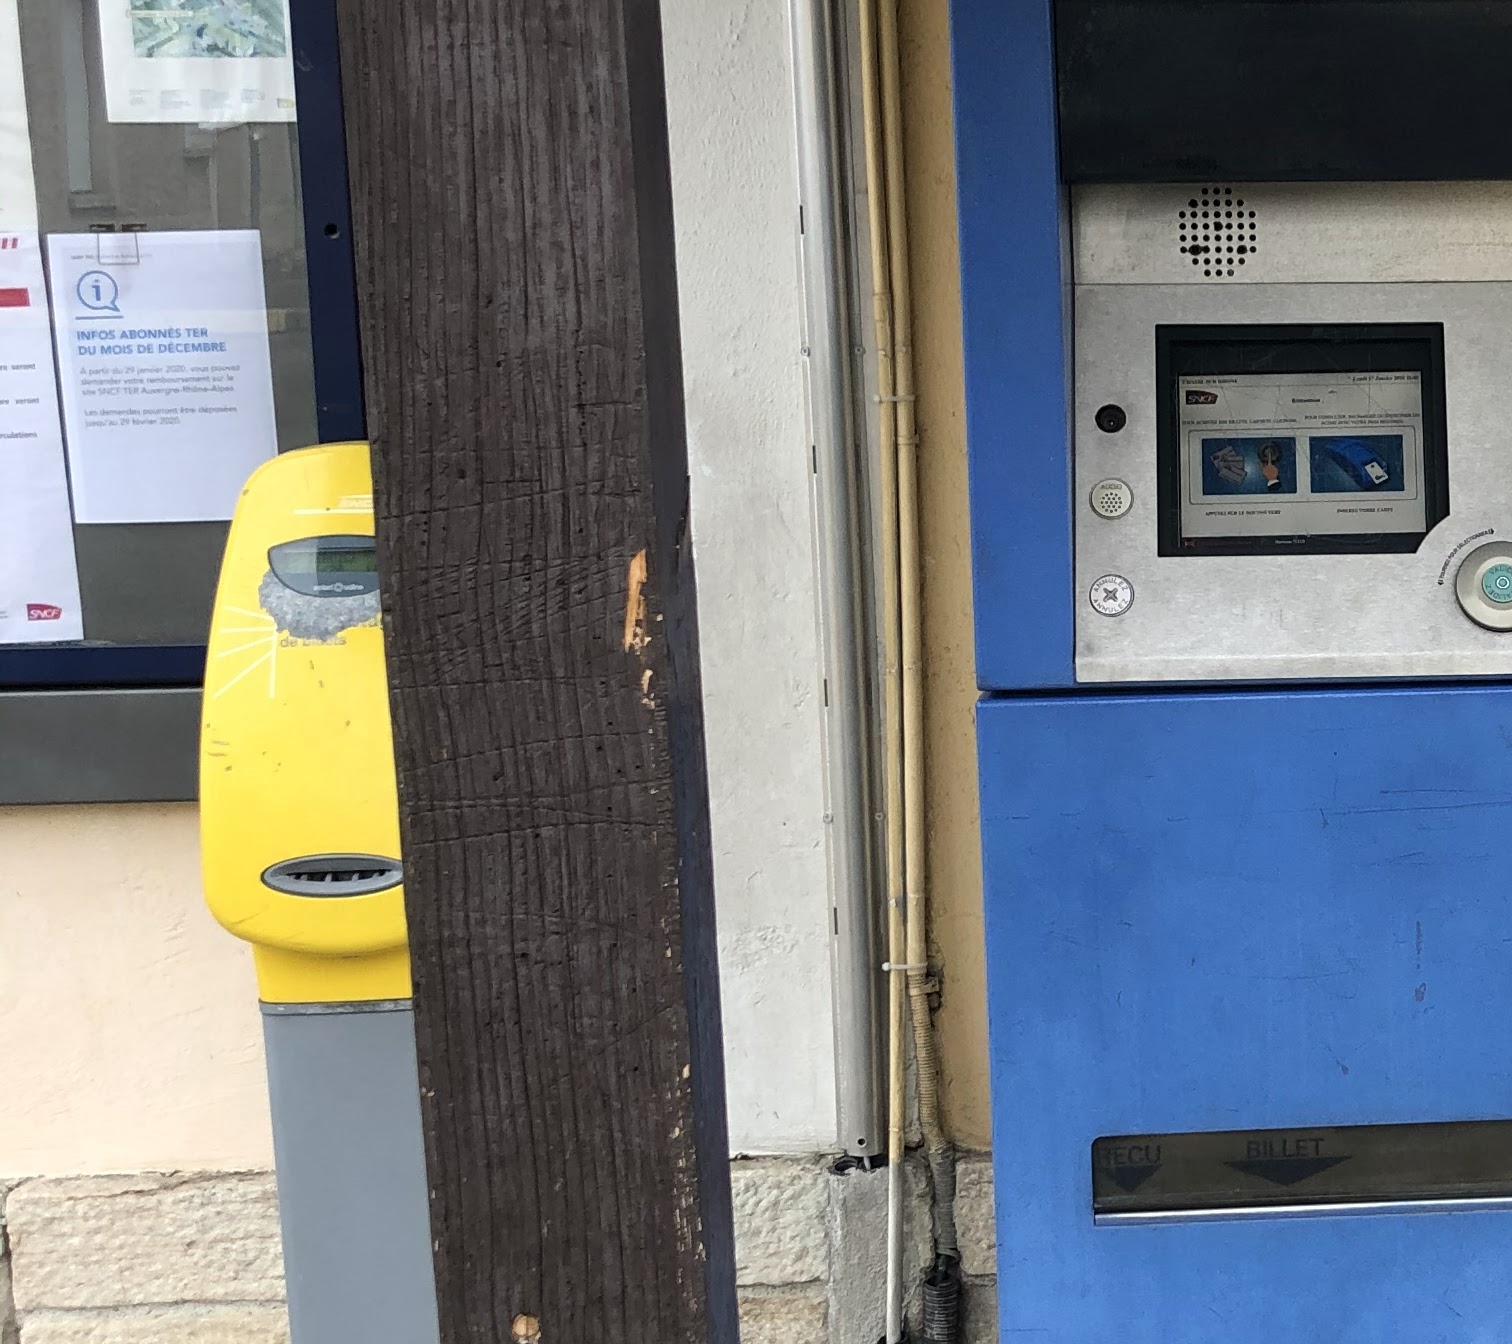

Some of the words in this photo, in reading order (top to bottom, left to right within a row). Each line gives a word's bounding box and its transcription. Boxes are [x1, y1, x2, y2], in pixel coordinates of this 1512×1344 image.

[76, 329, 116, 341] INFOS
[185, 327, 208, 338] TER
[78, 345, 96, 356] DU
[100, 344, 133, 355] MOIS
[137, 344, 154, 354] DE
[1094, 577, 1128, 592] ANNULEZ
[1093, 598, 1128, 613] ANNULEZ
[1247, 1137, 1325, 1159] BILLET
